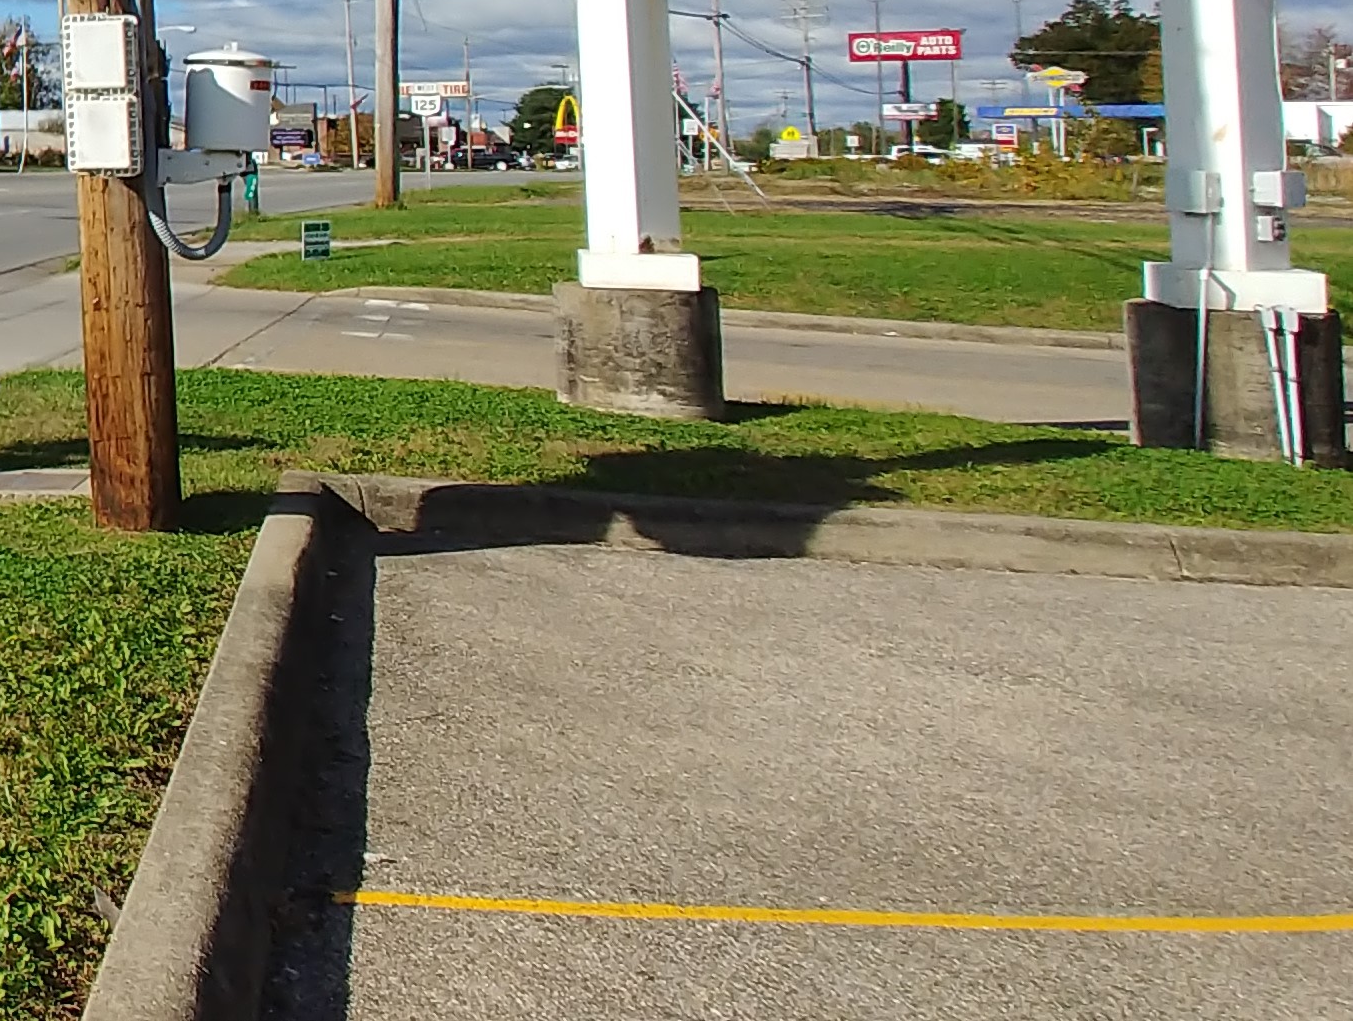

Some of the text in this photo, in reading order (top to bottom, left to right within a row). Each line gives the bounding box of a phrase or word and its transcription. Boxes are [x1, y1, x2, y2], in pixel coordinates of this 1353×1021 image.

[920, 35, 953, 45] AUTO
[916, 45, 957, 56] PARTS
[443, 84, 468, 94] TIRE
[415, 99, 437, 111] 125
